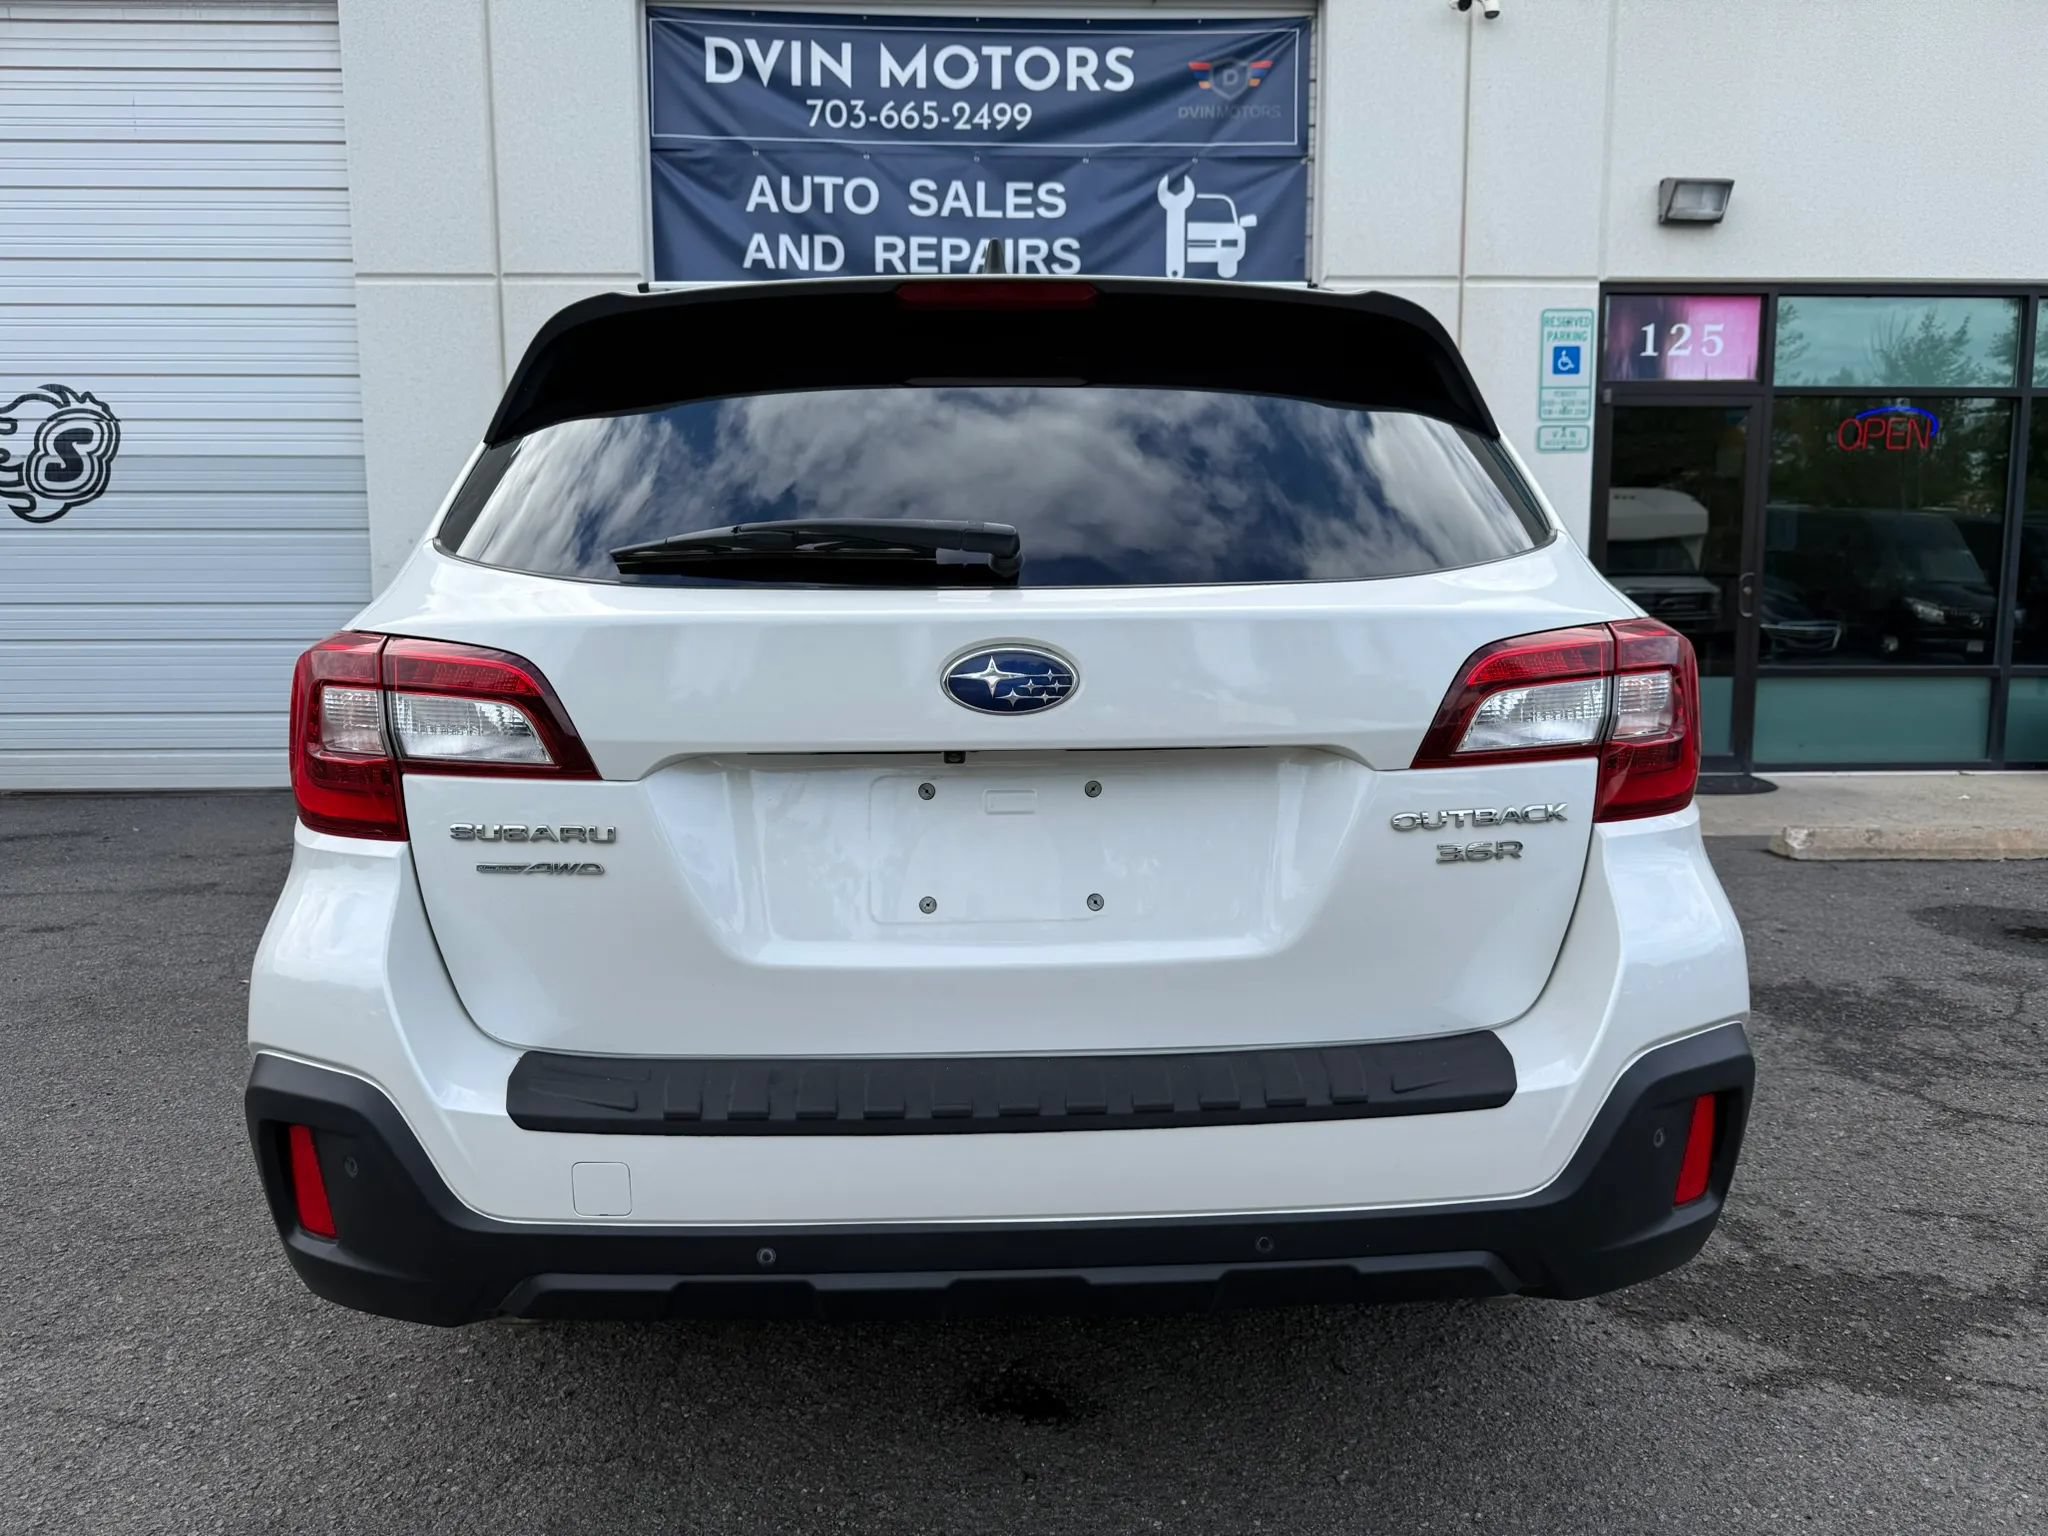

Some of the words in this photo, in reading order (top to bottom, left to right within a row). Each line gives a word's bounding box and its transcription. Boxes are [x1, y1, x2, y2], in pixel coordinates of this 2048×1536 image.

[704, 36, 853, 89] DVIN
[879, 43, 1135, 93] MOTORS
[805, 98, 1033, 132] 703-665-2499
[745, 176, 880, 216] AUTO
[908, 181, 1068, 219] SALES
[742, 233, 846, 272] AND
[1837, 418, 1931, 452] OPEN
[449, 823, 617, 844] SUBARU
[1390, 802, 1569, 832] OUTBACK
[524, 862, 606, 876] AWD
